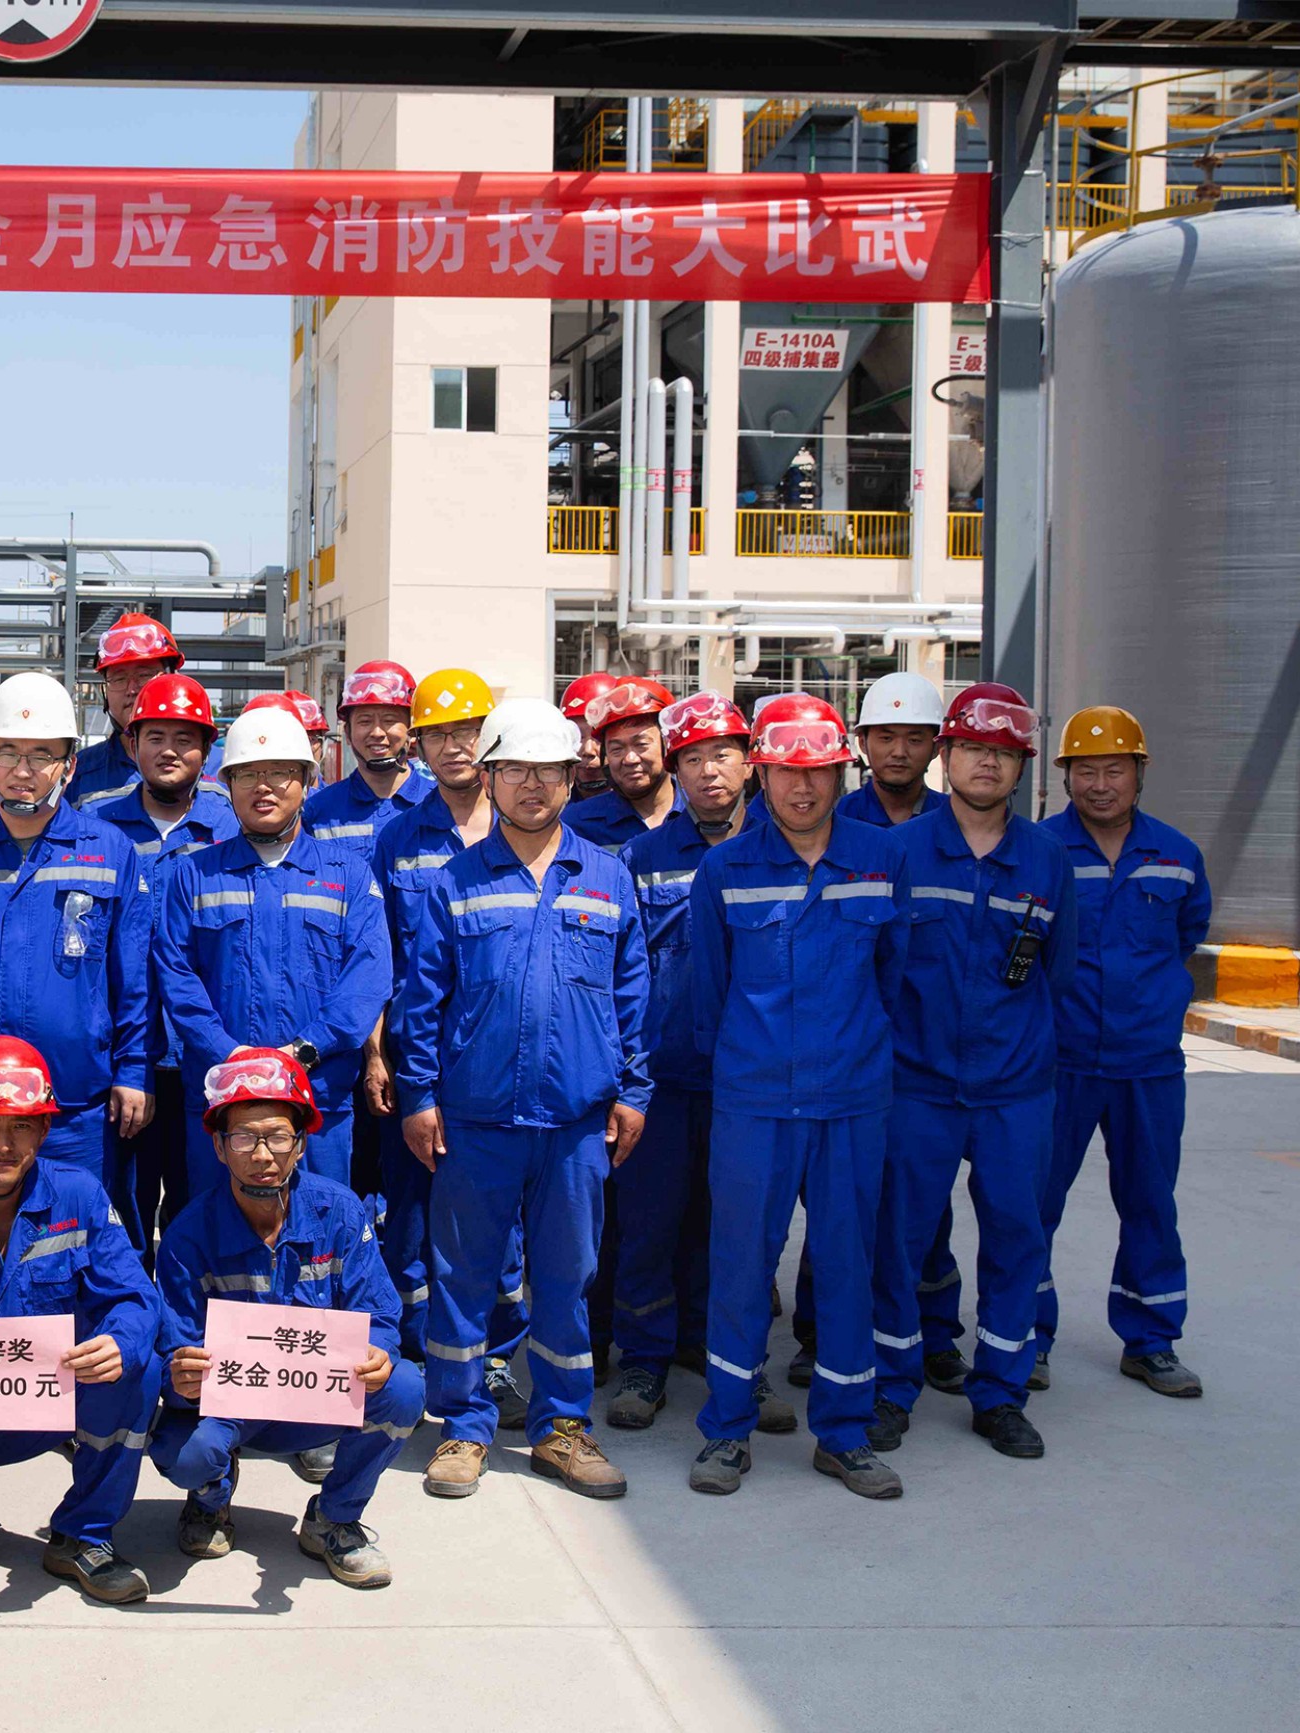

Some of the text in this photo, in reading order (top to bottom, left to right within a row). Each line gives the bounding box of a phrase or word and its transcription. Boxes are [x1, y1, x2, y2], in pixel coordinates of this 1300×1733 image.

[755, 332, 836, 348] E-1410A
[743, 350, 840, 368] 四级捕集器
[950, 354, 987, 372] 三级
[246, 1326, 327, 1356] 一等奖
[35, 1373, 61, 1398] 元
[217, 1360, 351, 1393] 奖金 900 元
